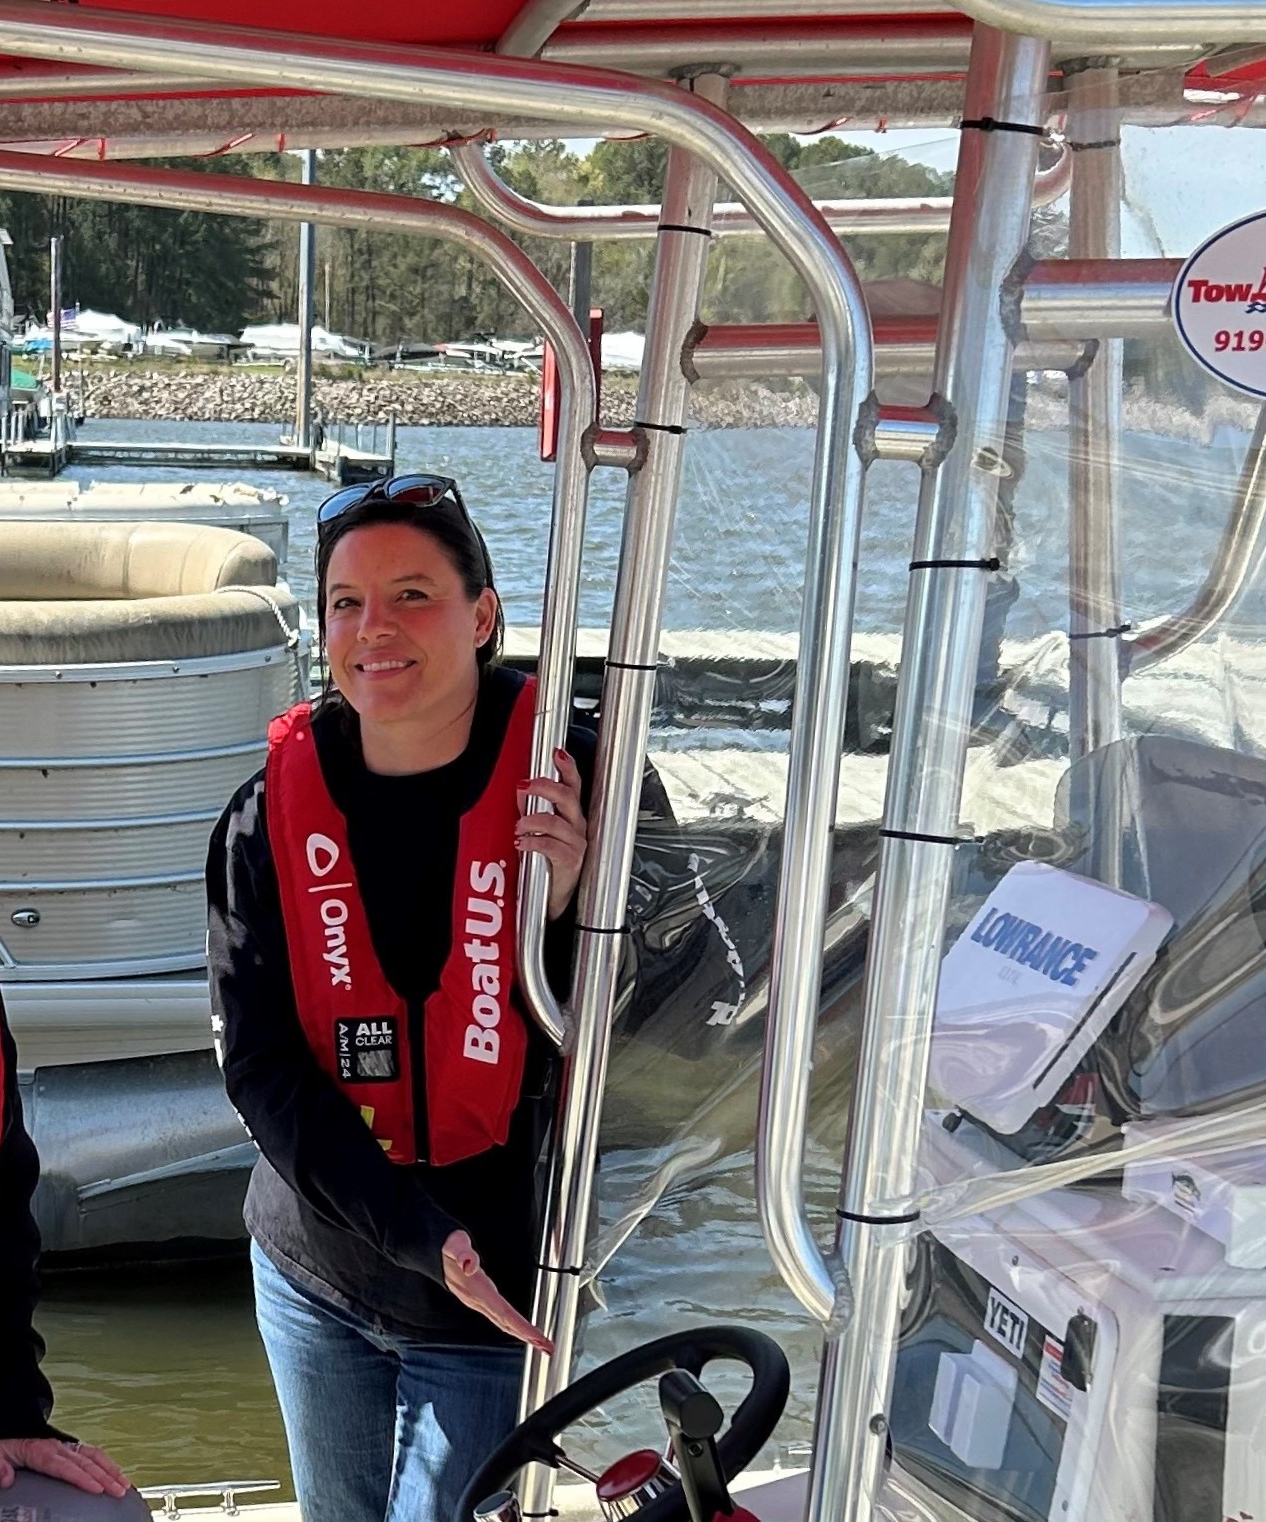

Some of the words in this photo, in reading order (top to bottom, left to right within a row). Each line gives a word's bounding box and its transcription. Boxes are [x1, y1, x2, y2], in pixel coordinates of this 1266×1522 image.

[971, 907, 1098, 987] LOWRANCE
[355, 1021, 393, 1036] ALL
[355, 1034, 393, 1047] CLEAR
[990, 1296, 1025, 1351] YETI
